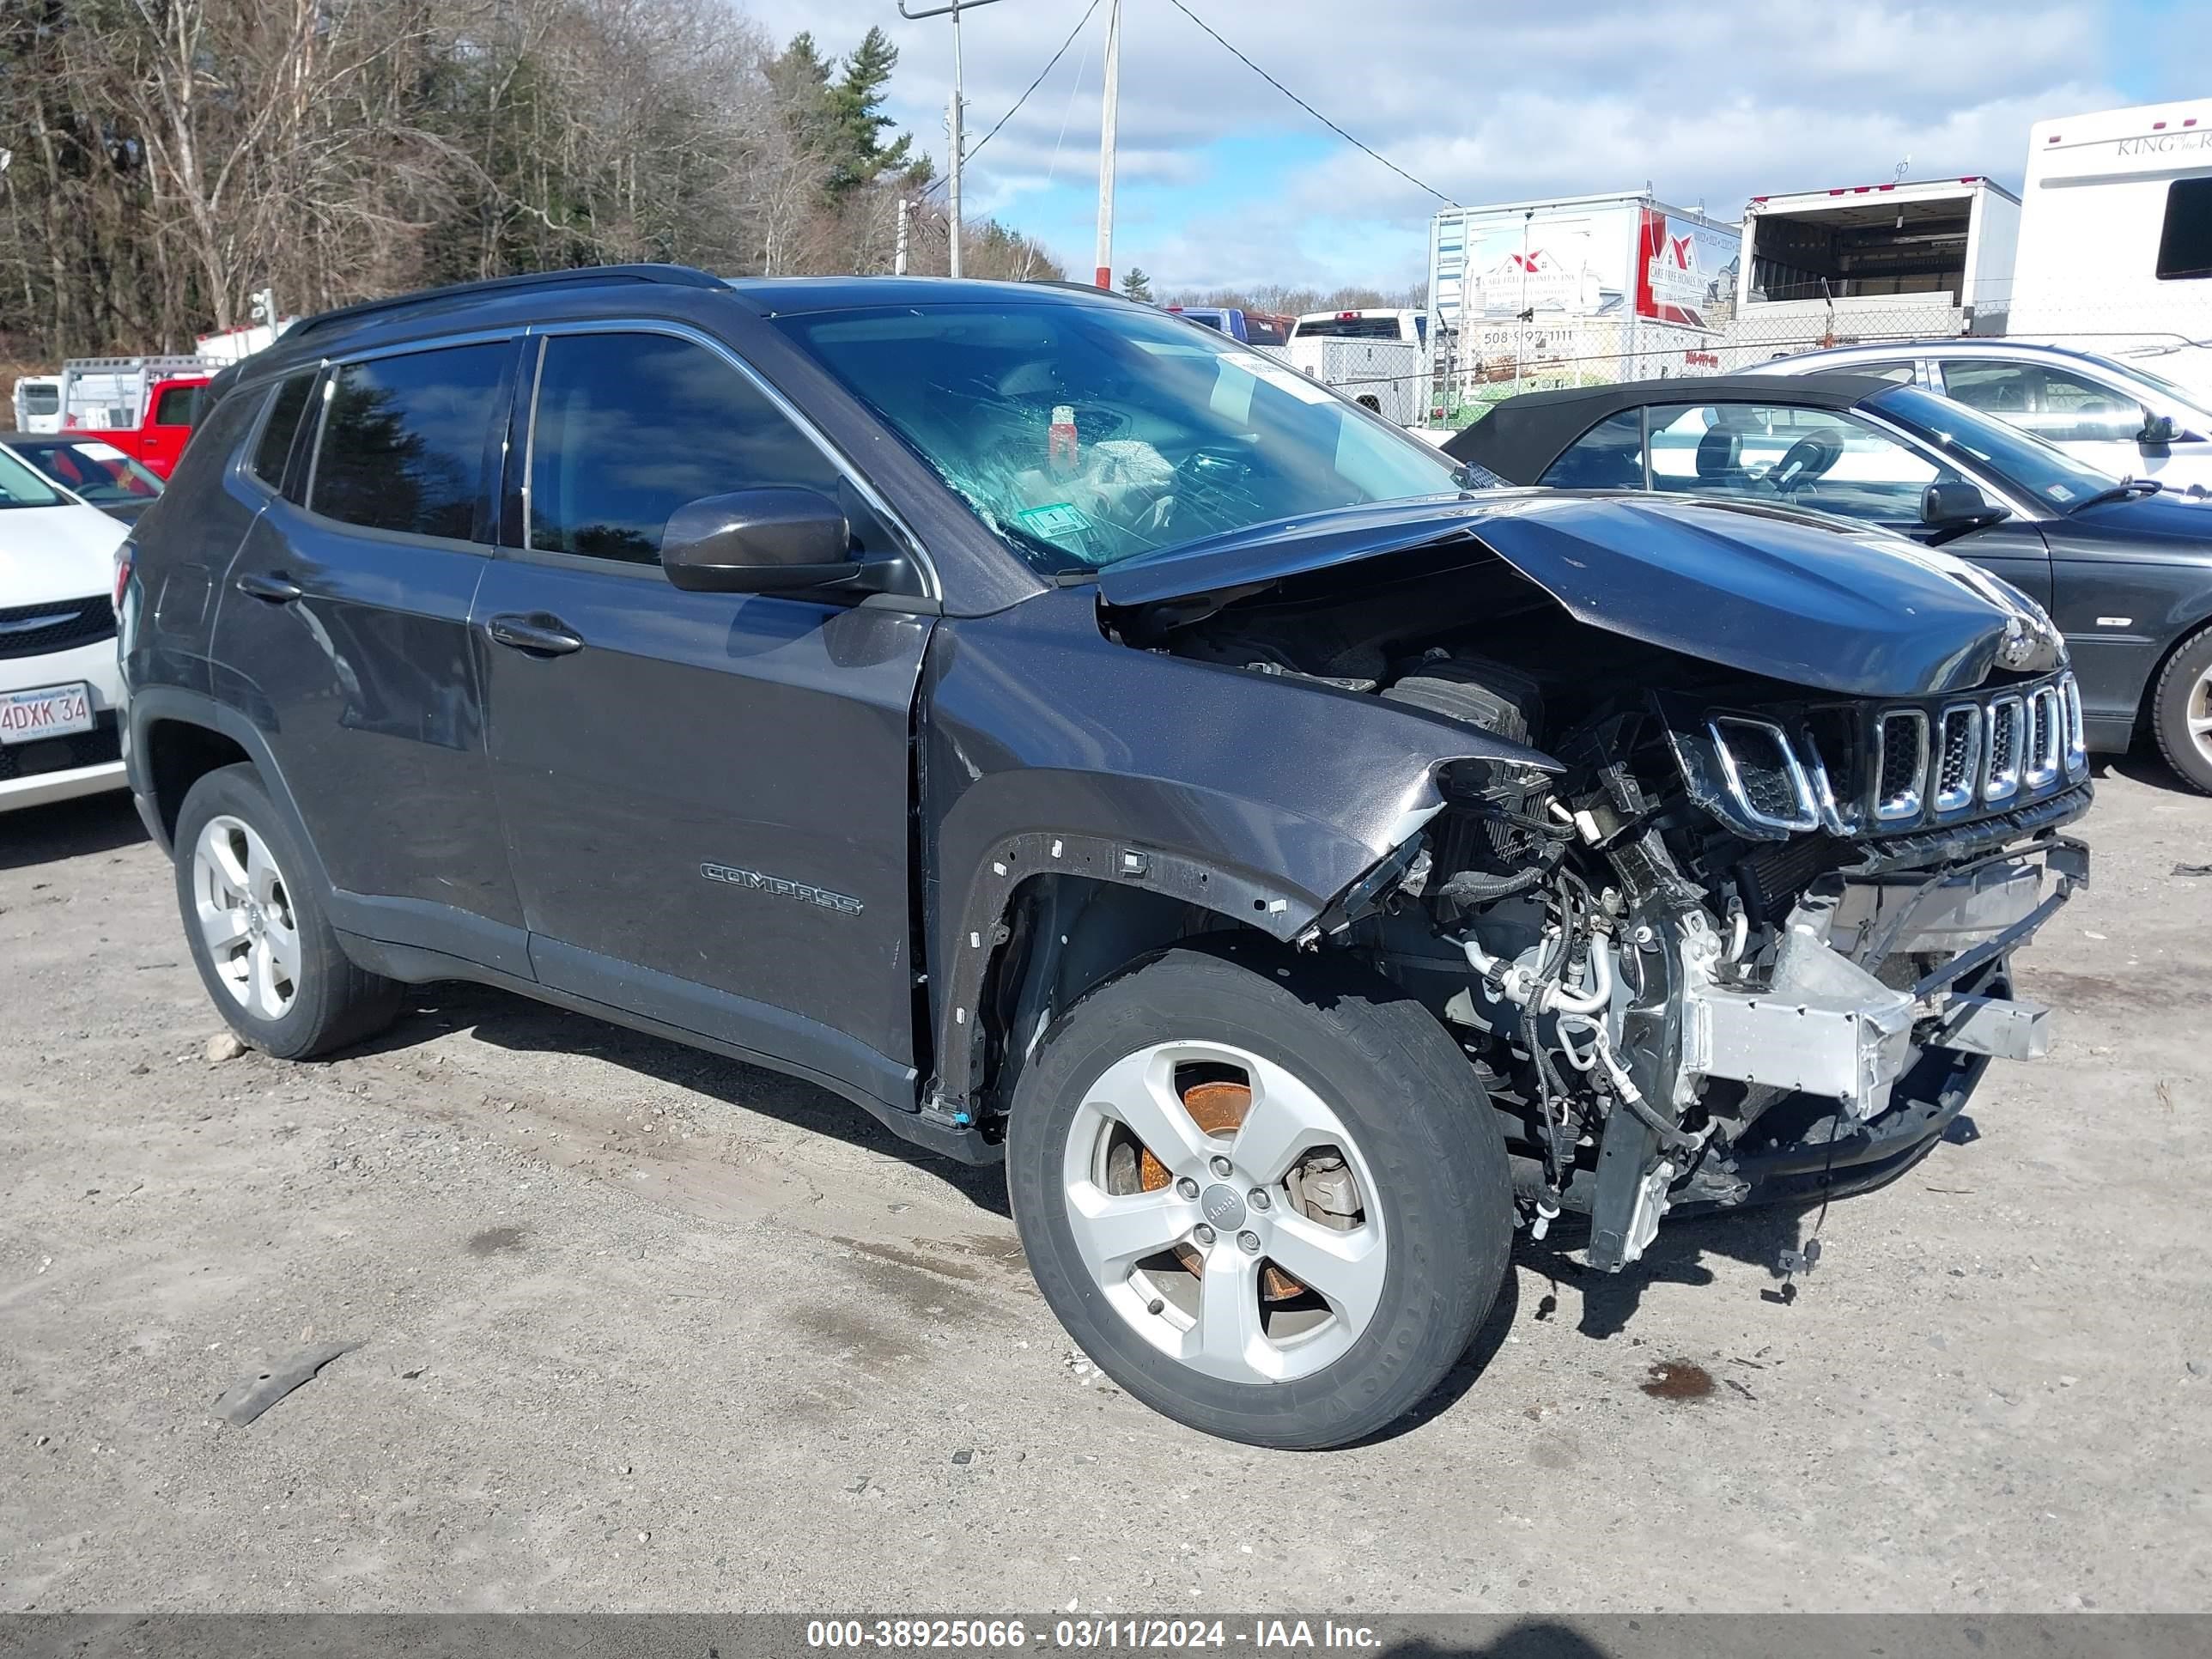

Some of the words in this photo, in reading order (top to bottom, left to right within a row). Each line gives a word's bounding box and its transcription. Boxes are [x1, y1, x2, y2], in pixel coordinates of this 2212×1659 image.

[2118, 136, 2174, 156] KING
[2, 700, 56, 730] 4DXK
[59, 696, 87, 720] 34
[701, 861, 864, 917] COMPASS
[1209, 1194, 1236, 1221] Jeep
